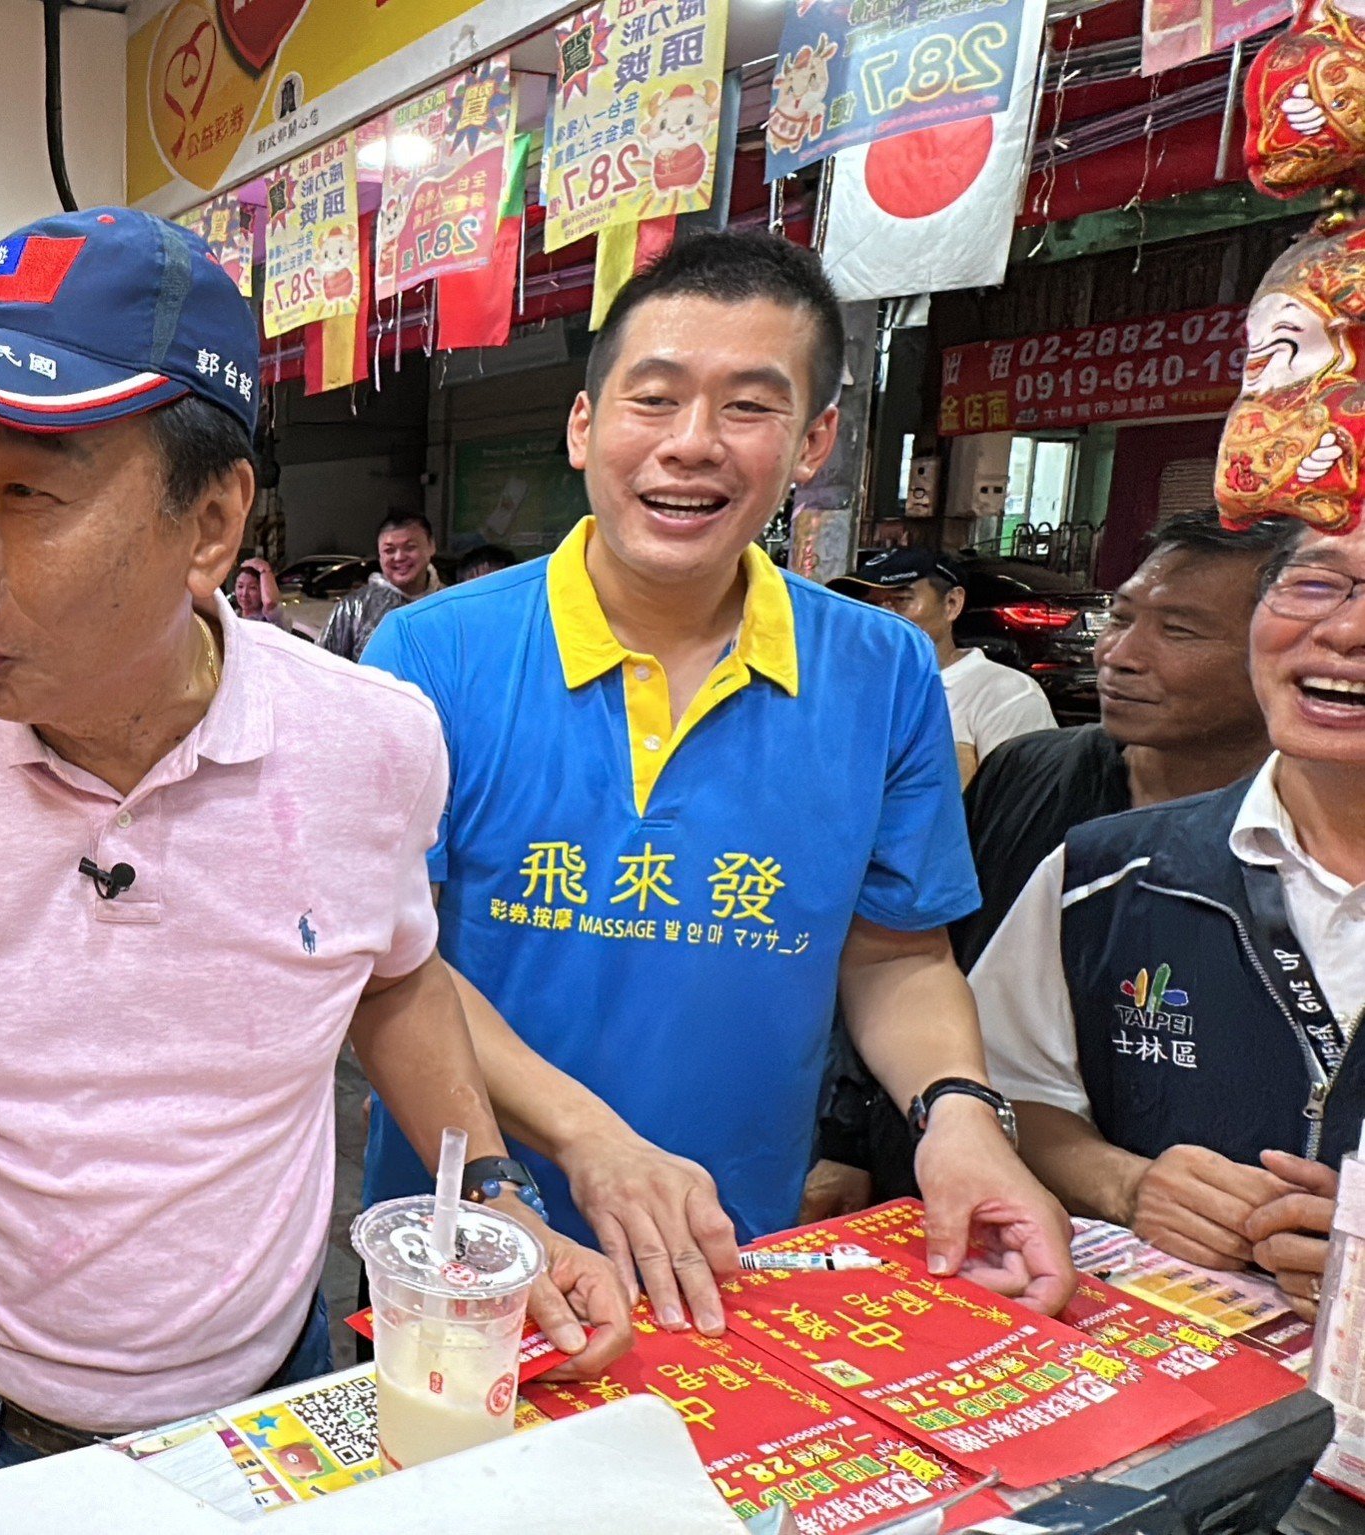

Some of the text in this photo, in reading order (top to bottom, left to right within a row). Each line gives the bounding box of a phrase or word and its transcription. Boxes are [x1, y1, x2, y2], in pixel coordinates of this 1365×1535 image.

[187, 104, 245, 162] 公益彩券
[519, 841, 786, 924] 飛來發
[579, 914, 656, 940] MASSAGE
[1273, 948, 1300, 971] UP
[1114, 1004, 1194, 1035] TAIPEI
[1112, 1030, 1197, 1069] 士林區
[789, 1431, 876, 1471] 一人獨得
[886, 1447, 945, 1485] 賀
